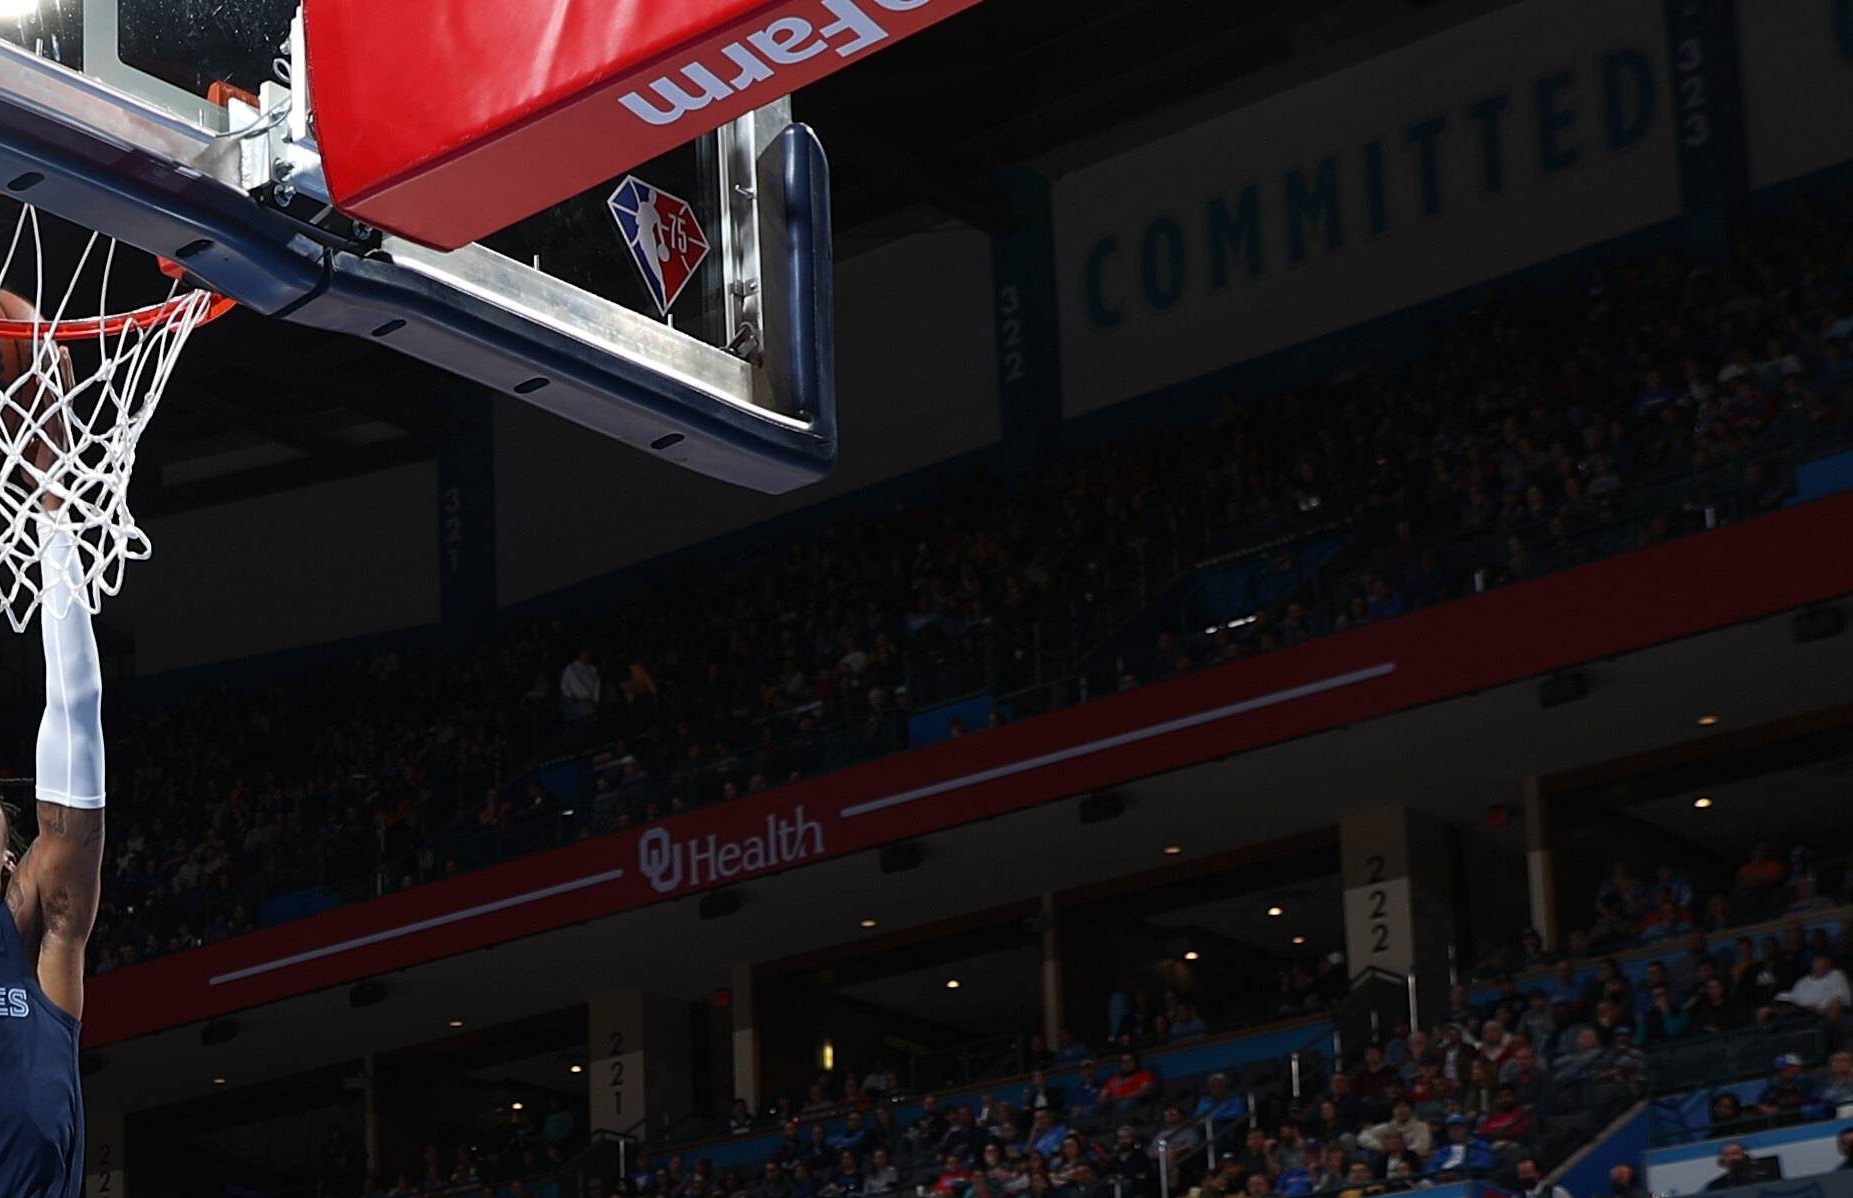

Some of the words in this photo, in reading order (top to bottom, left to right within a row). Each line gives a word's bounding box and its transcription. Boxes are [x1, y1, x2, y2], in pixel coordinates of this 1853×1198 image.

[617, 0, 889, 126] Farm
[1084, 48, 1657, 329] COMMITTED
[688, 804, 826, 887] Health
[1368, 856, 1389, 953] 222
[610, 1031, 625, 1116] 221
